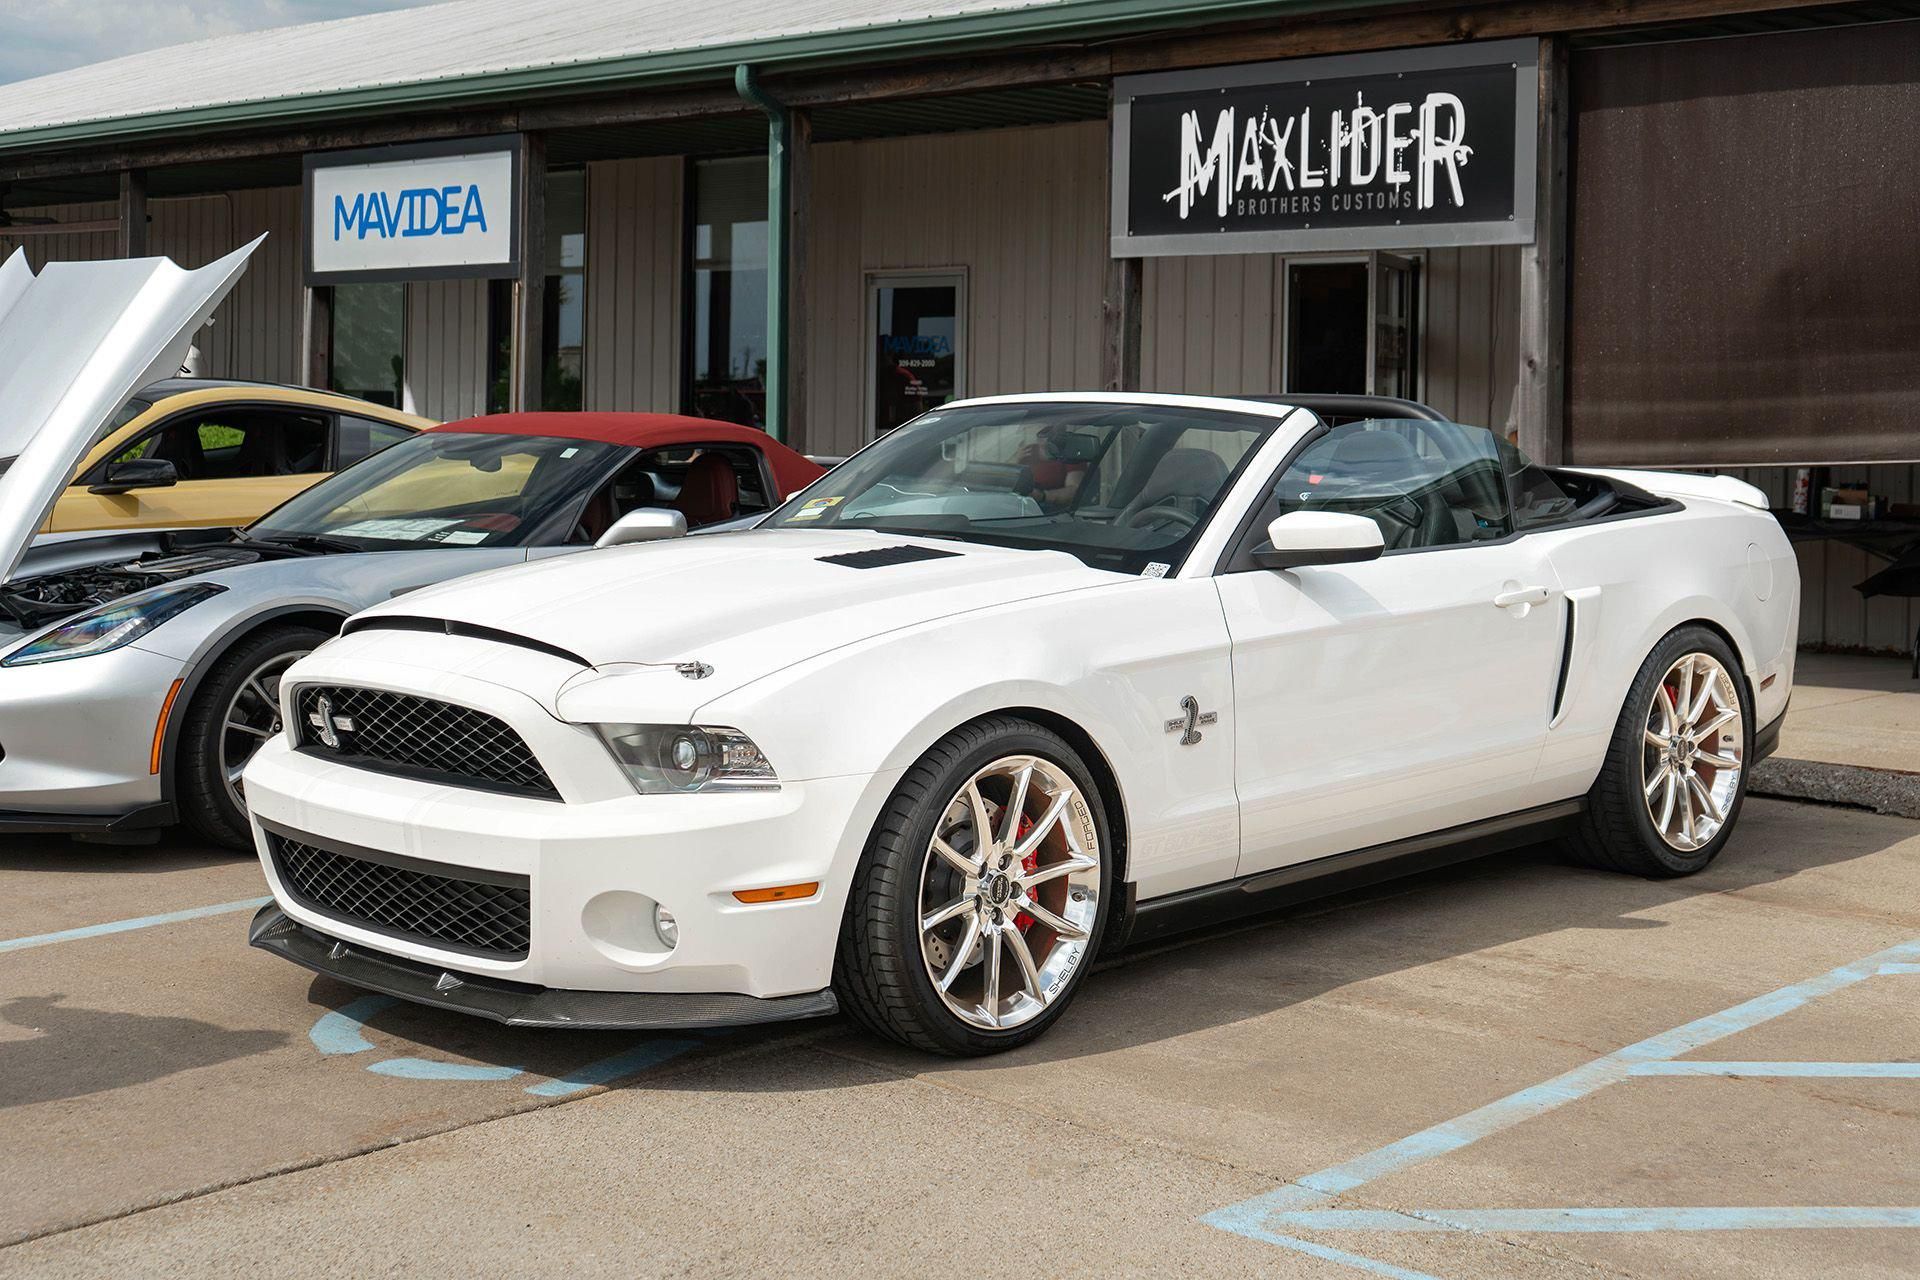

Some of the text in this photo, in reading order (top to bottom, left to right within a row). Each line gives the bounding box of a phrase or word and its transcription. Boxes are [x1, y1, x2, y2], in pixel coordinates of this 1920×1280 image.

[1164, 91, 1473, 219] MAXLIDER
[334, 184, 488, 241] MAVIDEA
[1237, 190, 1412, 216] BROTHERS CUSTOMS
[882, 335, 950, 353] MAVIDEA
[1074, 800, 1096, 850] FORGED
[1048, 947, 1080, 996] SHELBY
